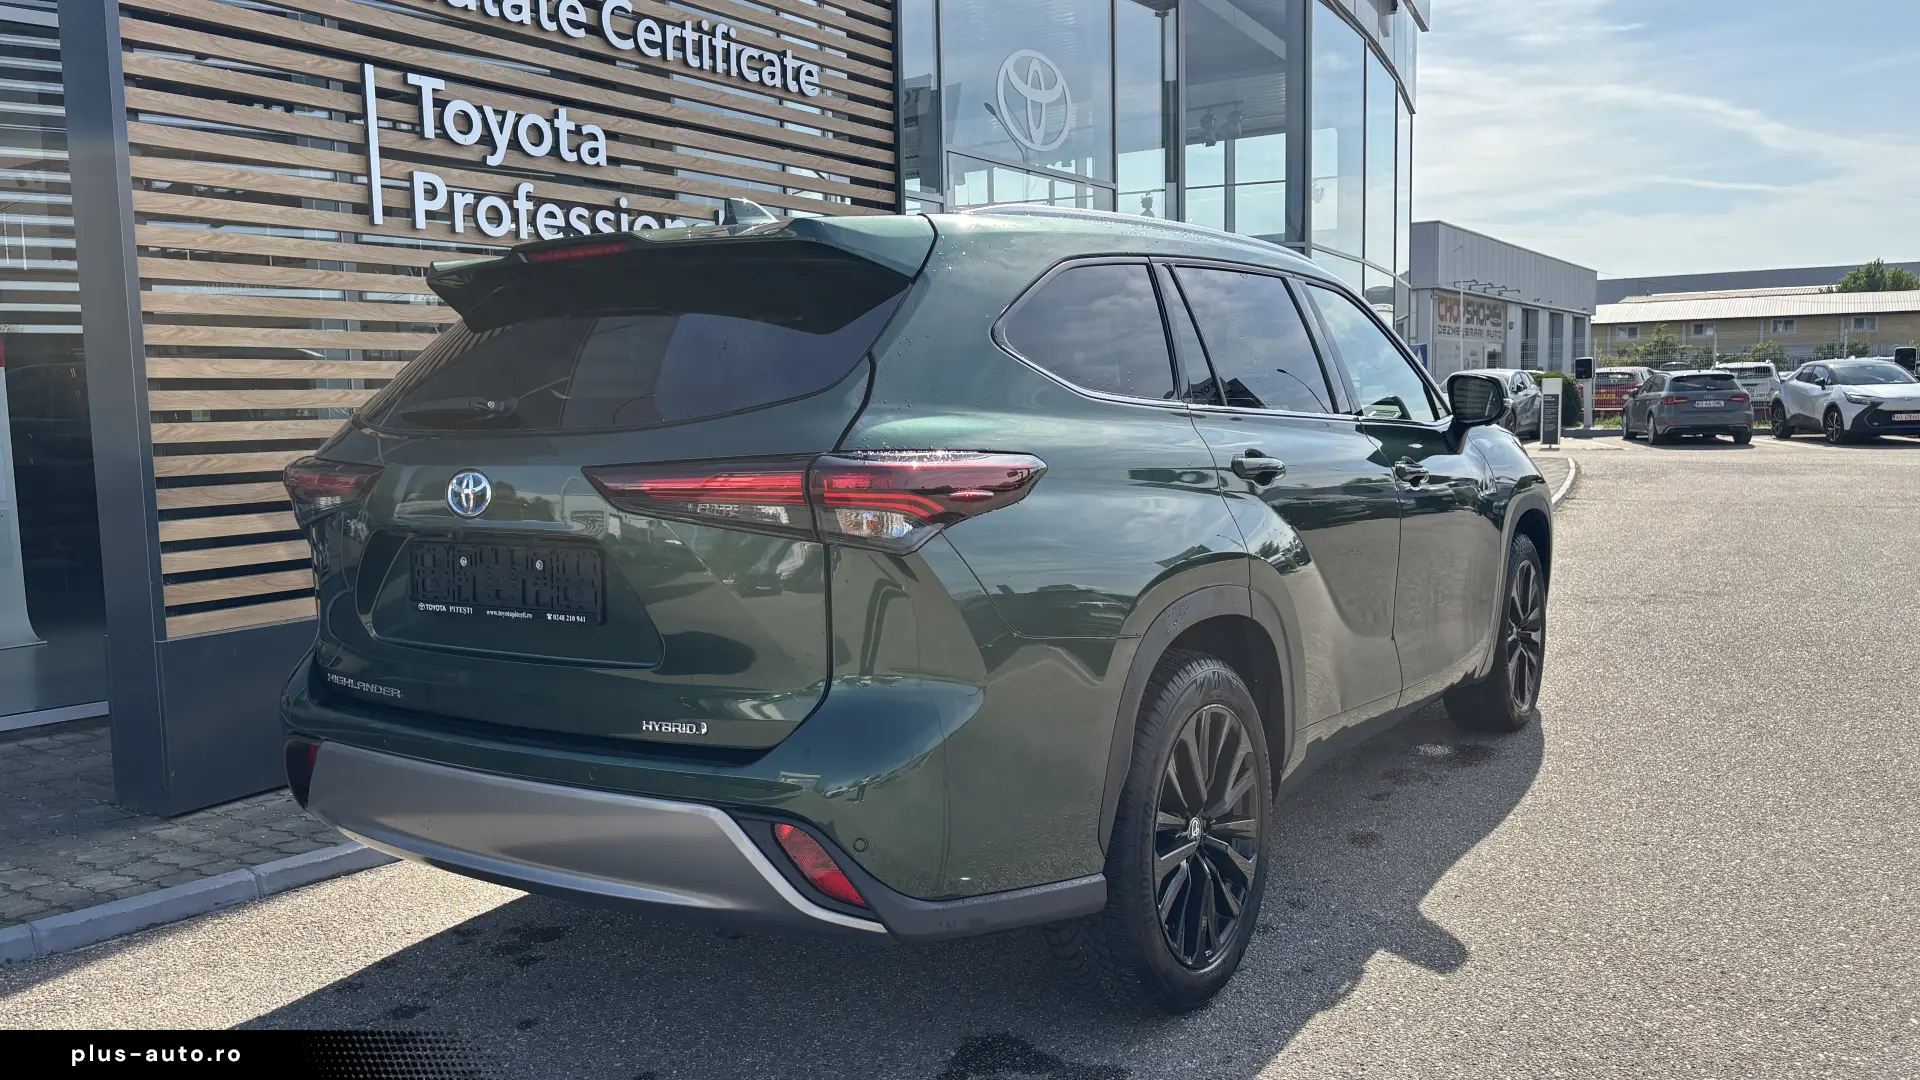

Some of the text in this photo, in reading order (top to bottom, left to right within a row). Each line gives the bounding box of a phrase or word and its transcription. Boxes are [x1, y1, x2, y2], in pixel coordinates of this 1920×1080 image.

[444, 0, 820, 97] ate Certificate
[407, 74, 607, 167] Toyota
[411, 170, 726, 240] Professi
[425, 603, 446, 612] TOYOTA
[576, 615, 586, 623] 941
[327, 672, 401, 698] HIGHLANDER
[642, 720, 697, 734] HYBRID
